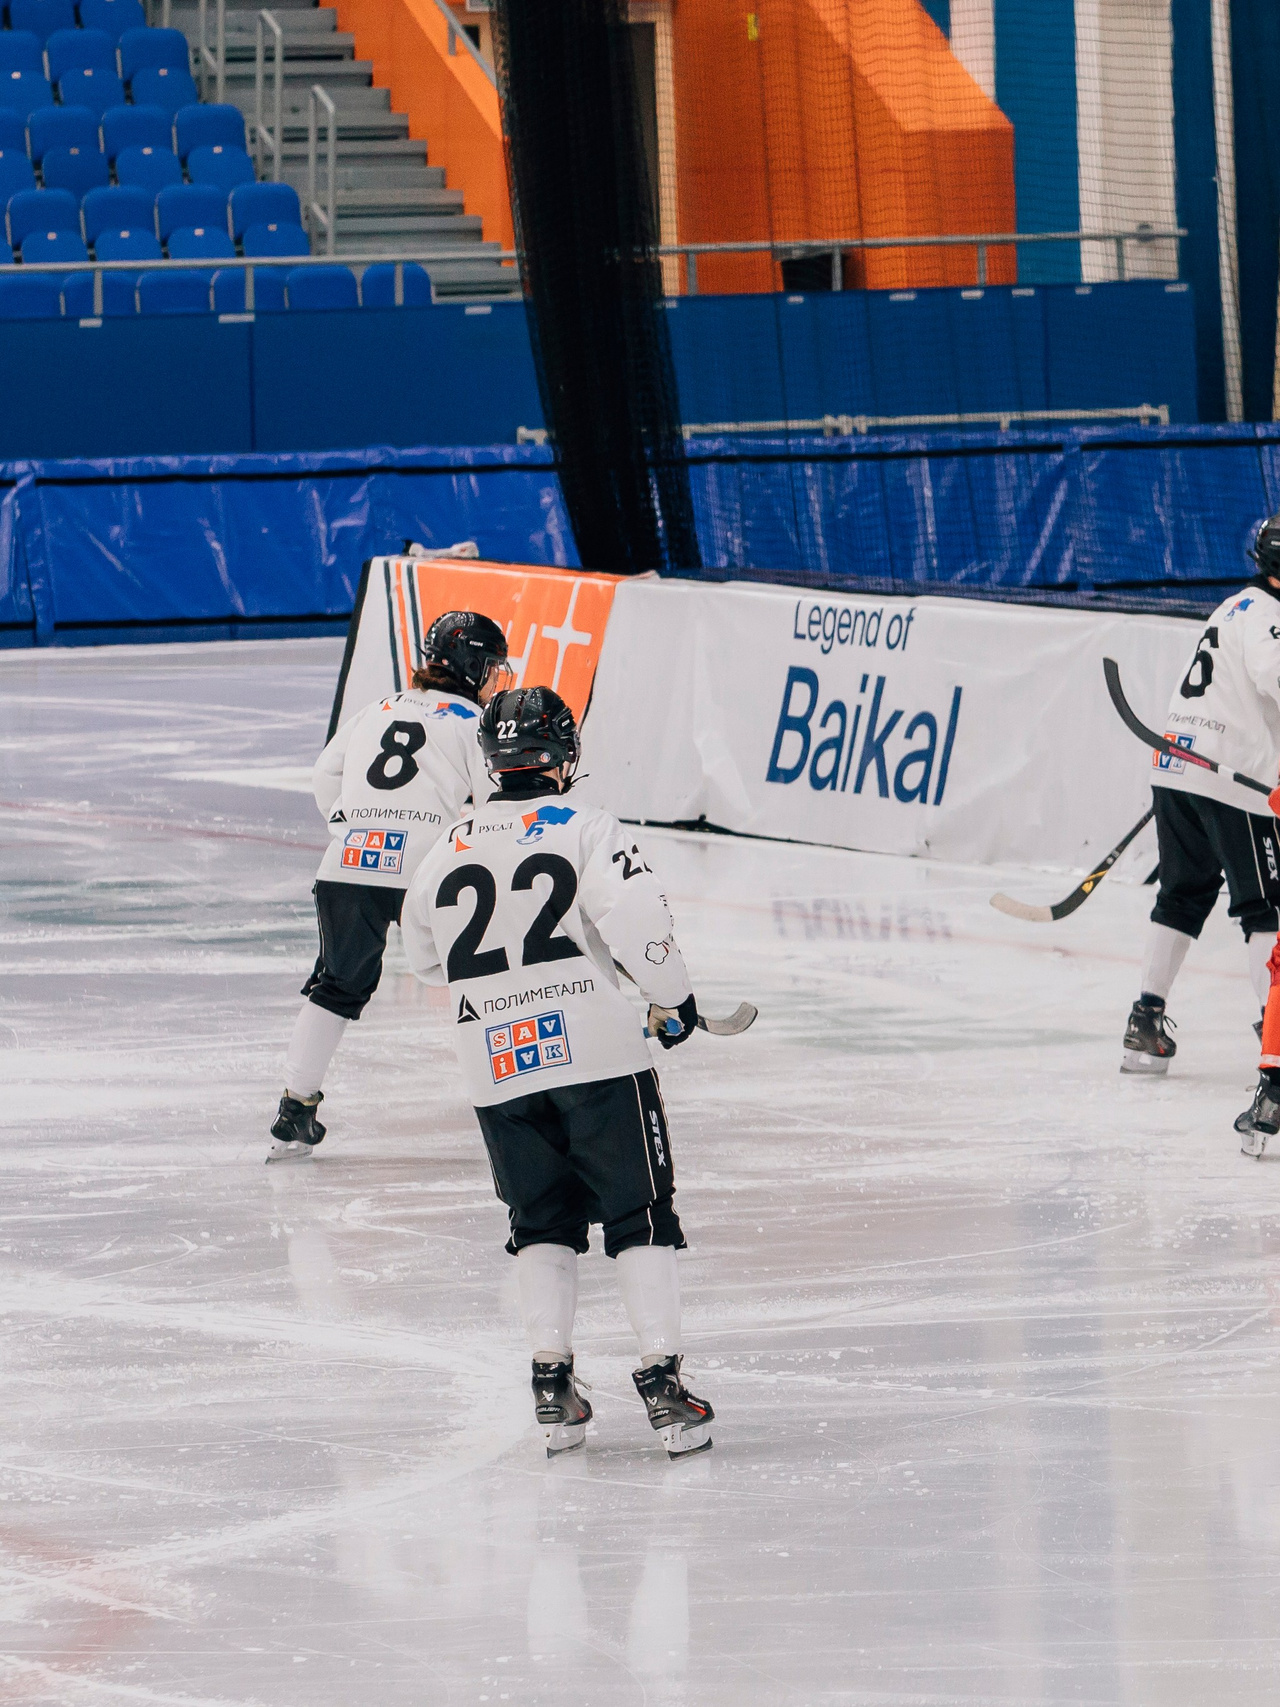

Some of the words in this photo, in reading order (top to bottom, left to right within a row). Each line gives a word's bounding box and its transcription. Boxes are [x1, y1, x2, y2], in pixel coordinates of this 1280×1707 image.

[793, 599, 884, 655] Legend
[886, 606, 917, 651] of
[1181, 626, 1219, 699] 6
[366, 720, 427, 790] 8
[496, 719, 519, 740] 22
[765, 664, 963, 807] Baikal
[350, 807, 442, 825] ПОЛИМЕТАЛЛ
[478, 822, 514, 834] РУСАЛ
[435, 852, 586, 984] 22
[484, 979, 595, 1014] ПОЛИМЕТАЛЛ
